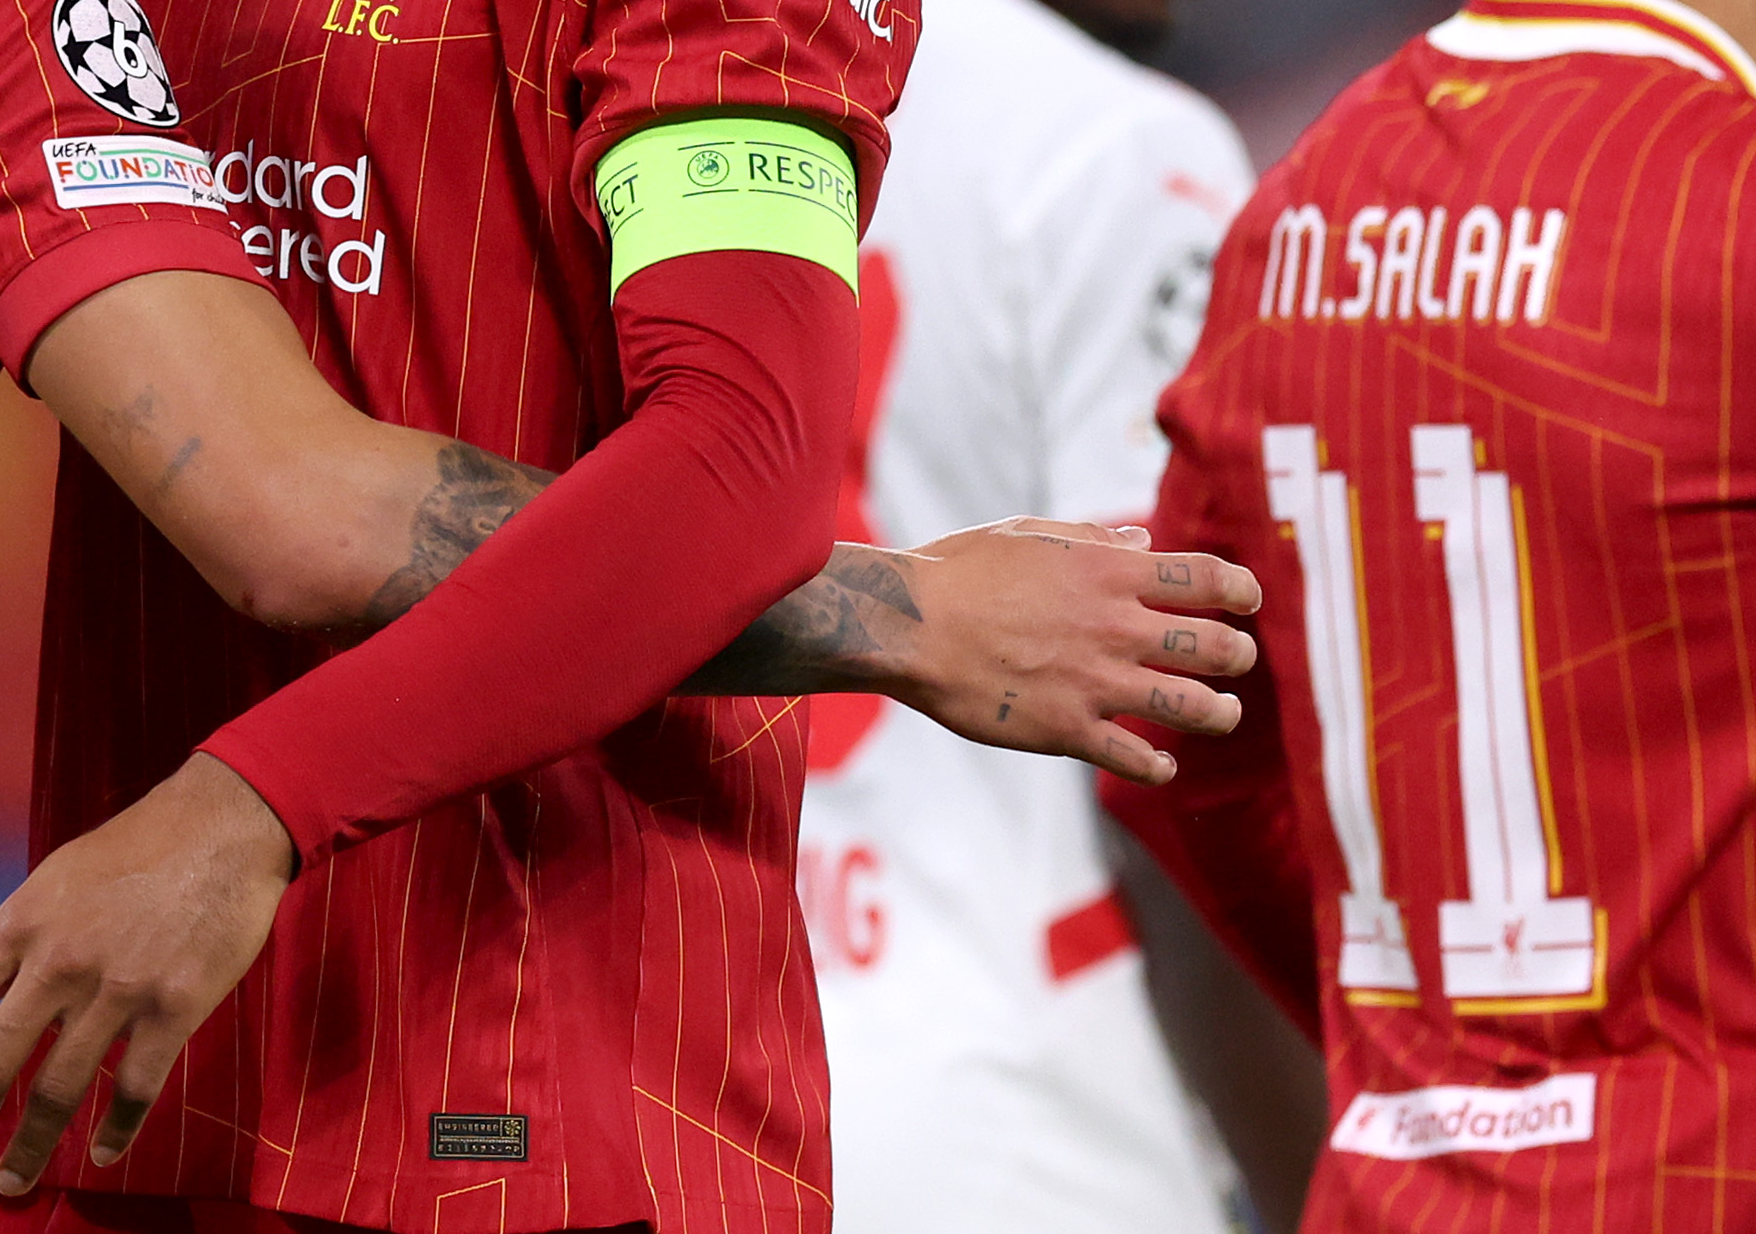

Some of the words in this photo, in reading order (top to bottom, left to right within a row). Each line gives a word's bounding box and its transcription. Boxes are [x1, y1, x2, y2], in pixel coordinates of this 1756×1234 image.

[52, 142, 97, 158] UEFA
[205, 139, 367, 220] dard
[230, 220, 386, 296] ered
[1258, 203, 1569, 328] M.SALAH
[1262, 424, 1607, 1012] 11
